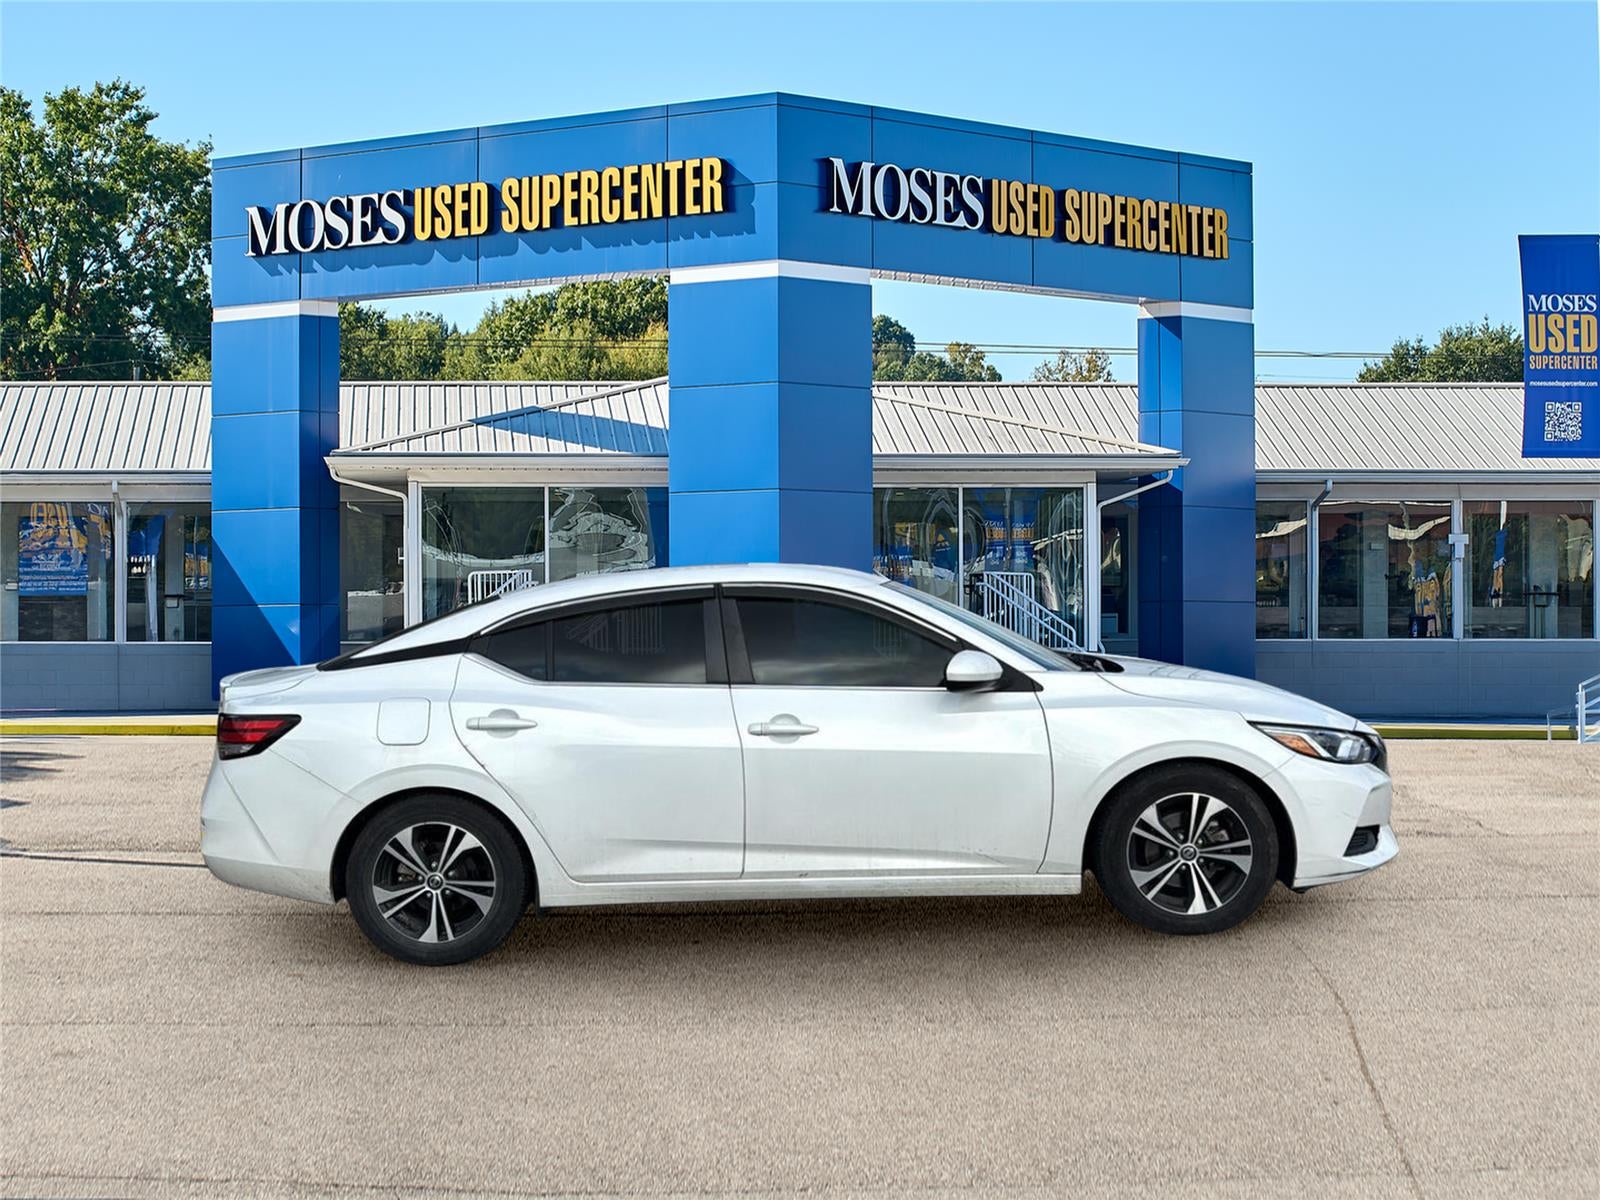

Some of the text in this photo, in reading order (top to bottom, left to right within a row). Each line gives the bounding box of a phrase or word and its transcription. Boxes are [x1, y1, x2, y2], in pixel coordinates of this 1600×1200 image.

[245, 157, 724, 257] MOSES USED SUPERCENTER
[829, 157, 1229, 260] MOSES USED SUPERCENTER
[1528, 294, 1597, 312] MOSES
[1528, 314, 1598, 353] USED
[1529, 355, 1598, 370] SUPERCENTER
